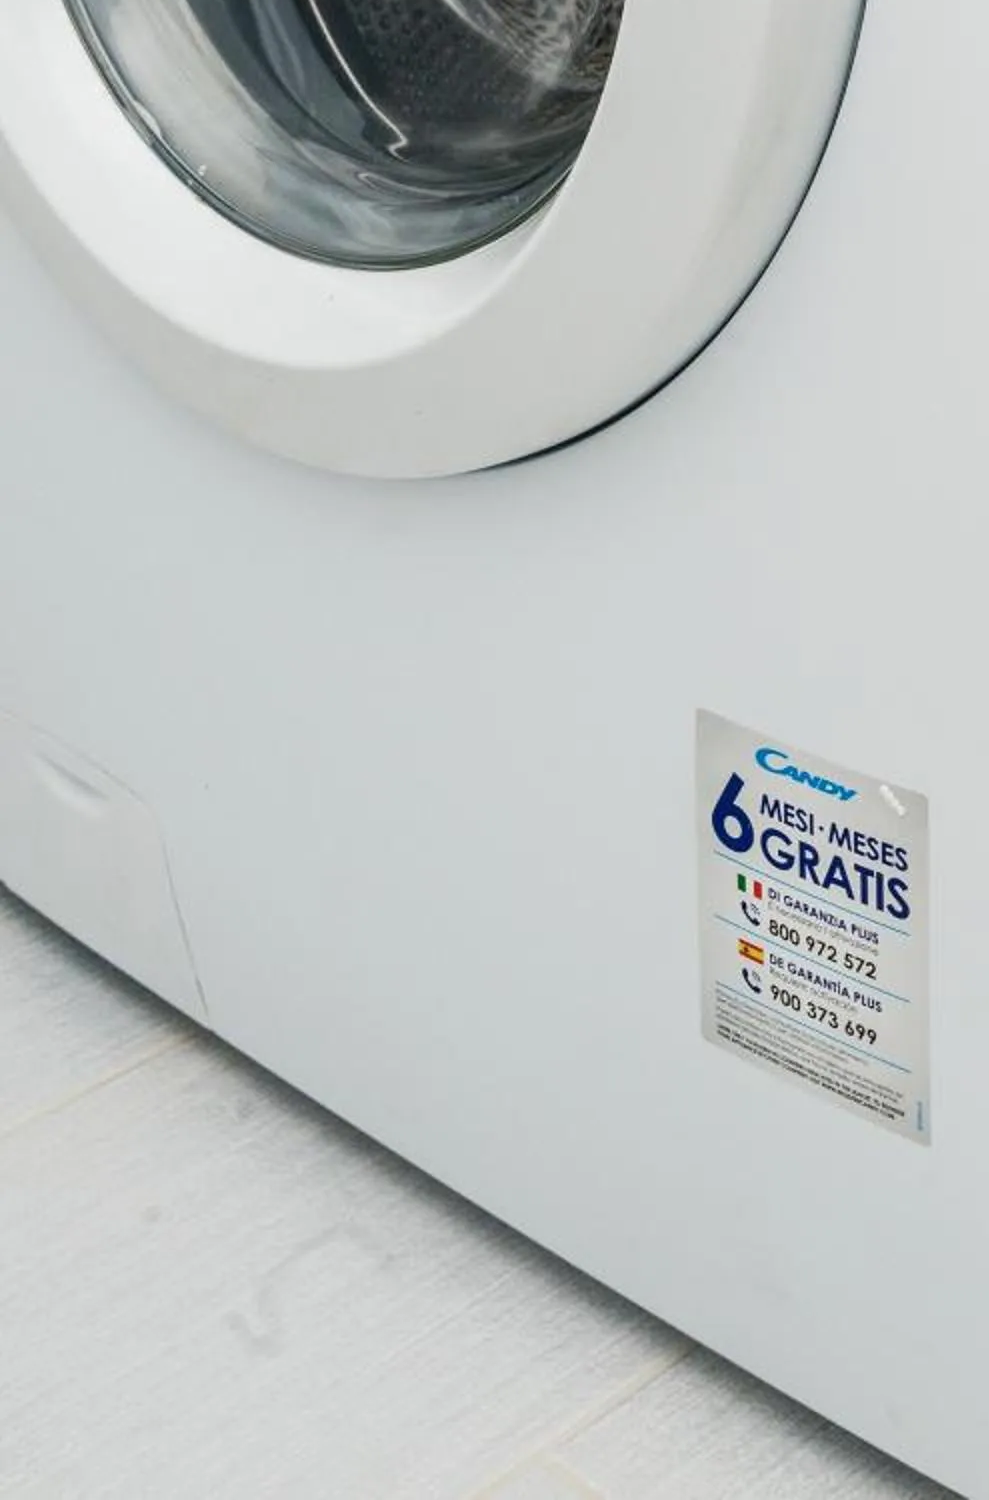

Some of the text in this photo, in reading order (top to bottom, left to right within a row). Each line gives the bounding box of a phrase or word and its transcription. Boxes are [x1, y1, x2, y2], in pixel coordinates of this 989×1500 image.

[755, 746, 860, 802] CANDY
[711, 771, 755, 854] 6
[760, 792, 909, 873] MESI MESES
[760, 827, 912, 921] GRATIS
[767, 887, 781, 901] DI
[851, 923, 880, 945] PLUS
[768, 919, 801, 947] 800
[805, 935, 838, 963] 972
[844, 952, 878, 980] 572
[768, 953, 785, 969] DE
[787, 963, 851, 1000] GARANTÍA
[852, 991, 884, 1013] PLUS
[770, 984, 802, 1012] 900
[806, 1001, 840, 1029] 373
[845, 1020, 878, 1046] 699
